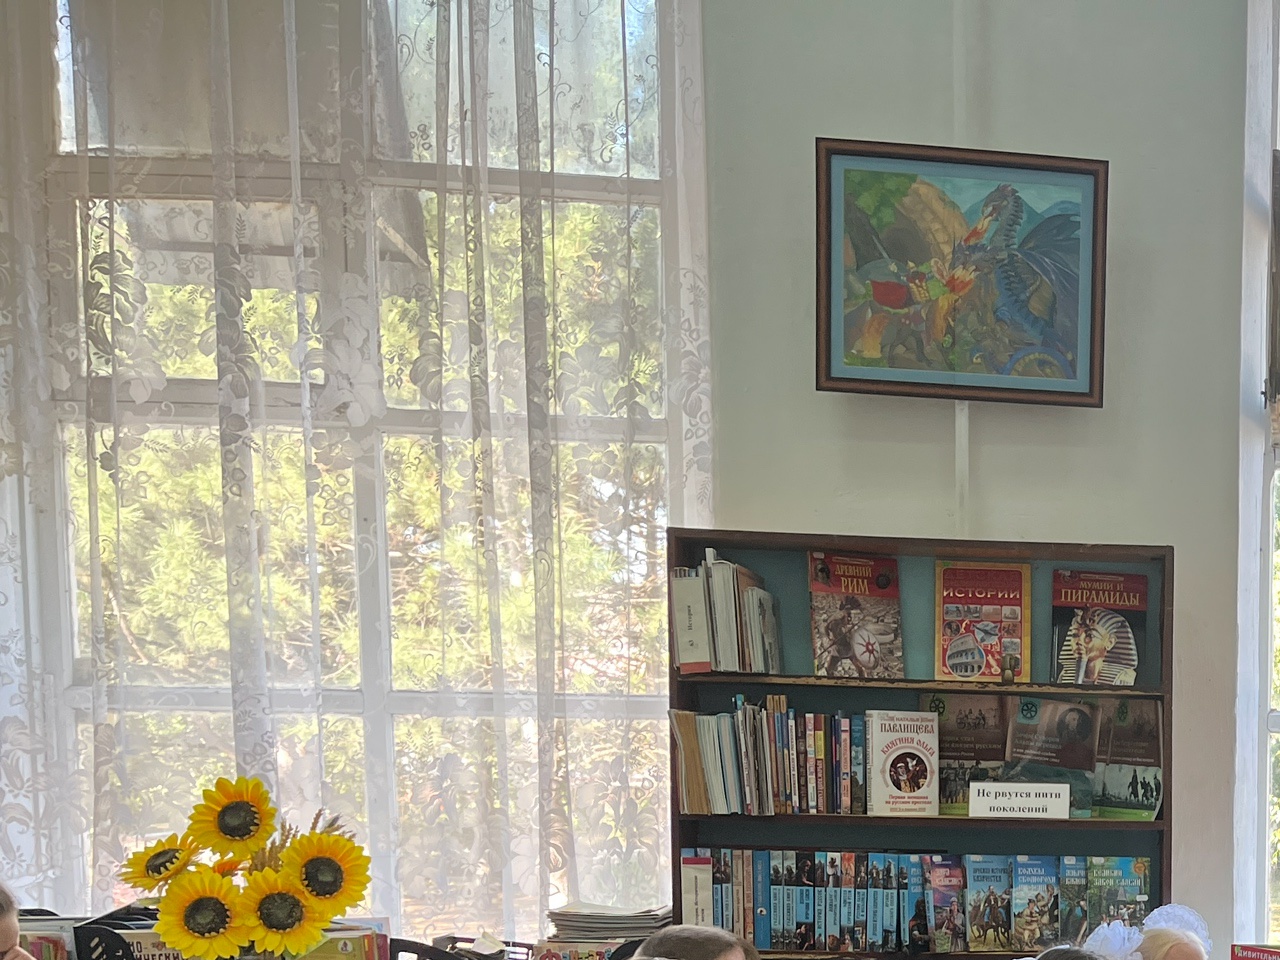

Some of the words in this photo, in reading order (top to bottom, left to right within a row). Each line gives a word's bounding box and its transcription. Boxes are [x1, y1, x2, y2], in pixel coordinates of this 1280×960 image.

[834, 564, 872, 577] ДРЕВНИЙ
[841, 577, 870, 594] РИМ
[1080, 581, 1113, 590] МУМИИ
[1116, 583, 1124, 591] И
[943, 588, 1020, 598] ИСТОРИИ
[1060, 588, 1140, 606] ПИРАМИДЫ
[880, 723, 934, 735] ПАВЛИЩЕВА
[880, 736, 914, 755] КНЯГИНЯ
[916, 739, 936, 757] ОЛЬГА
[977, 789, 992, 798] Не
[994, 790, 1031, 800] рвутся
[989, 805, 1048, 813] поколений
